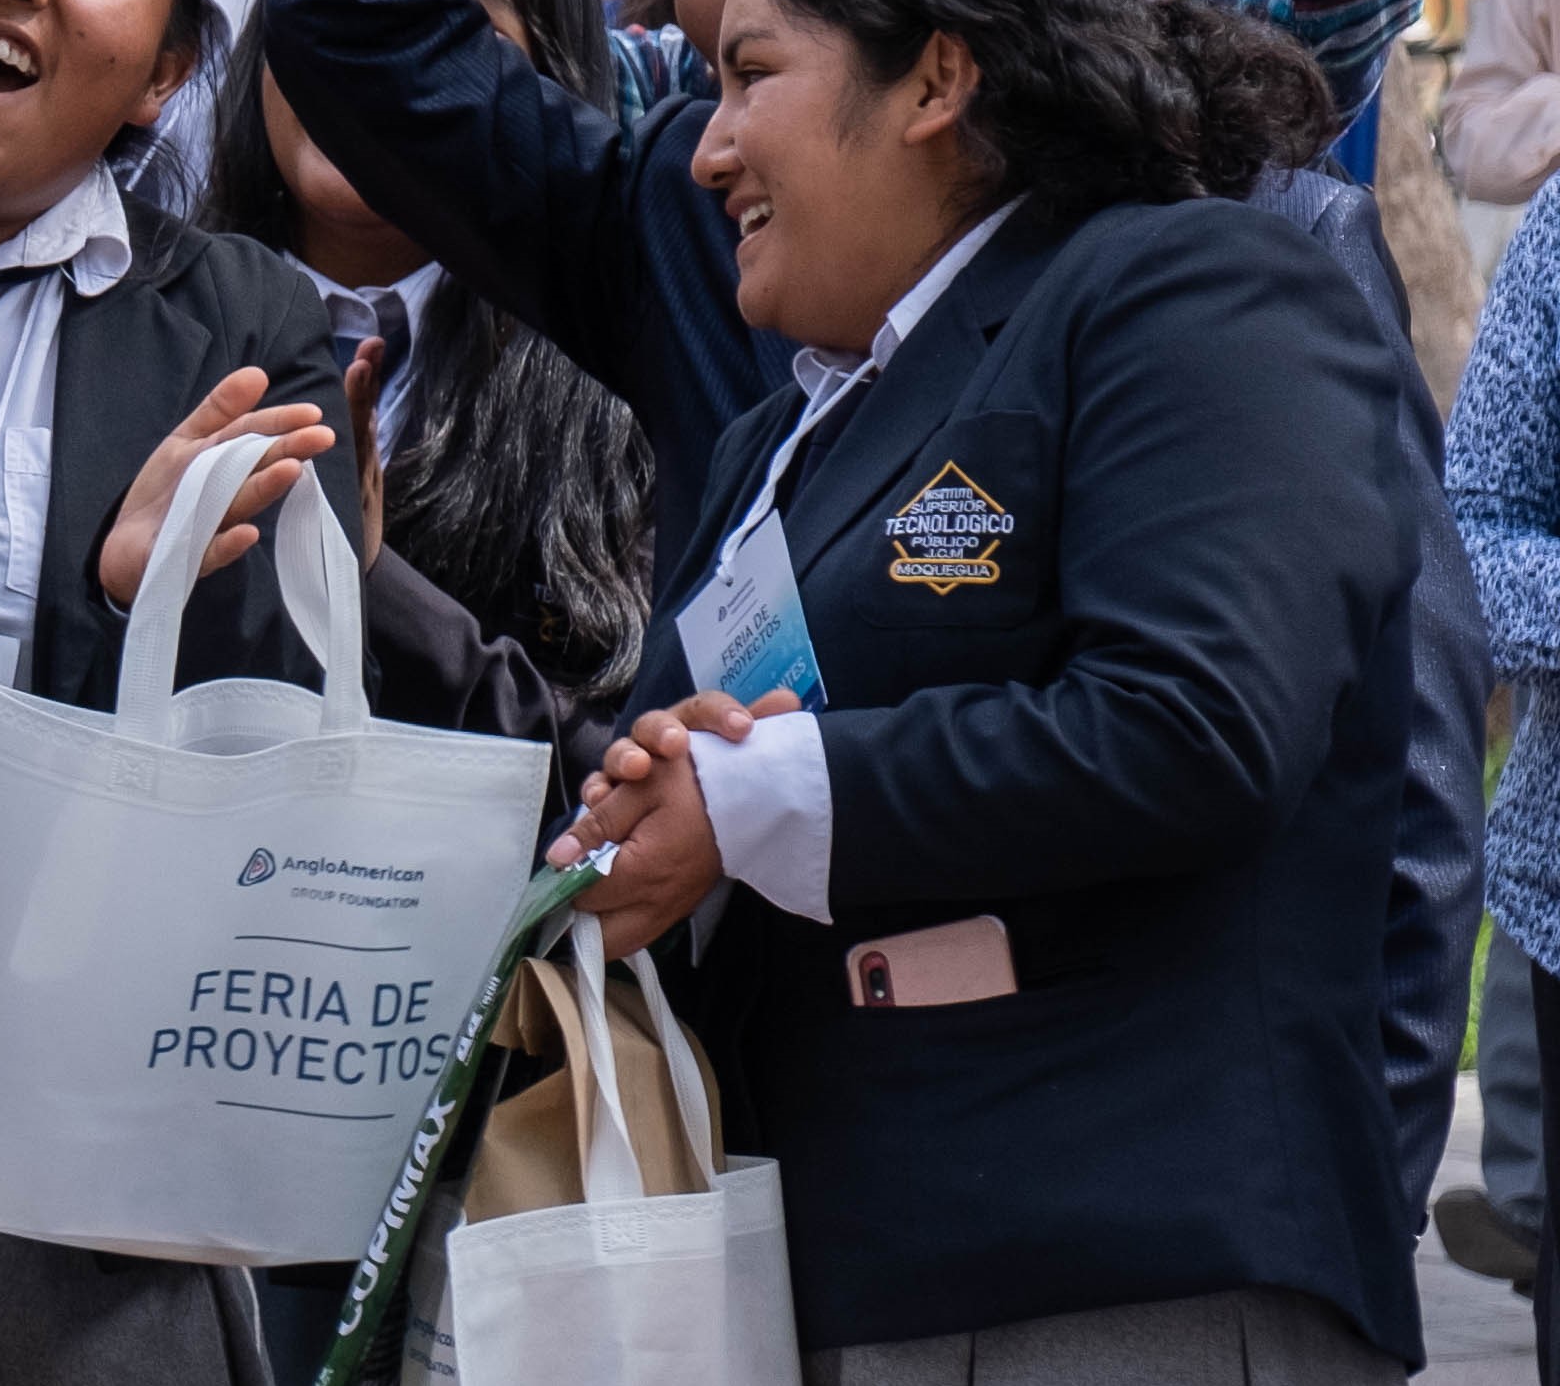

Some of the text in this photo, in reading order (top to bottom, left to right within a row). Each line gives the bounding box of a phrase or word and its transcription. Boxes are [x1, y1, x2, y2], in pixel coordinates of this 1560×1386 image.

[885, 514, 1014, 536] TECNOLOGICO
[909, 500, 986, 514] SUPERIOR
[720, 615, 782, 692] PROYECTOS
[721, 625, 754, 667] FERIA
[753, 604, 770, 632] DE
[282, 856, 424, 883] AngloAmerican
[290, 886, 420, 910] GROUP FOUNDATION
[190, 969, 350, 1026] FERIA
[371, 980, 434, 1028] DE
[147, 1025, 451, 1085] PROYECTOS
